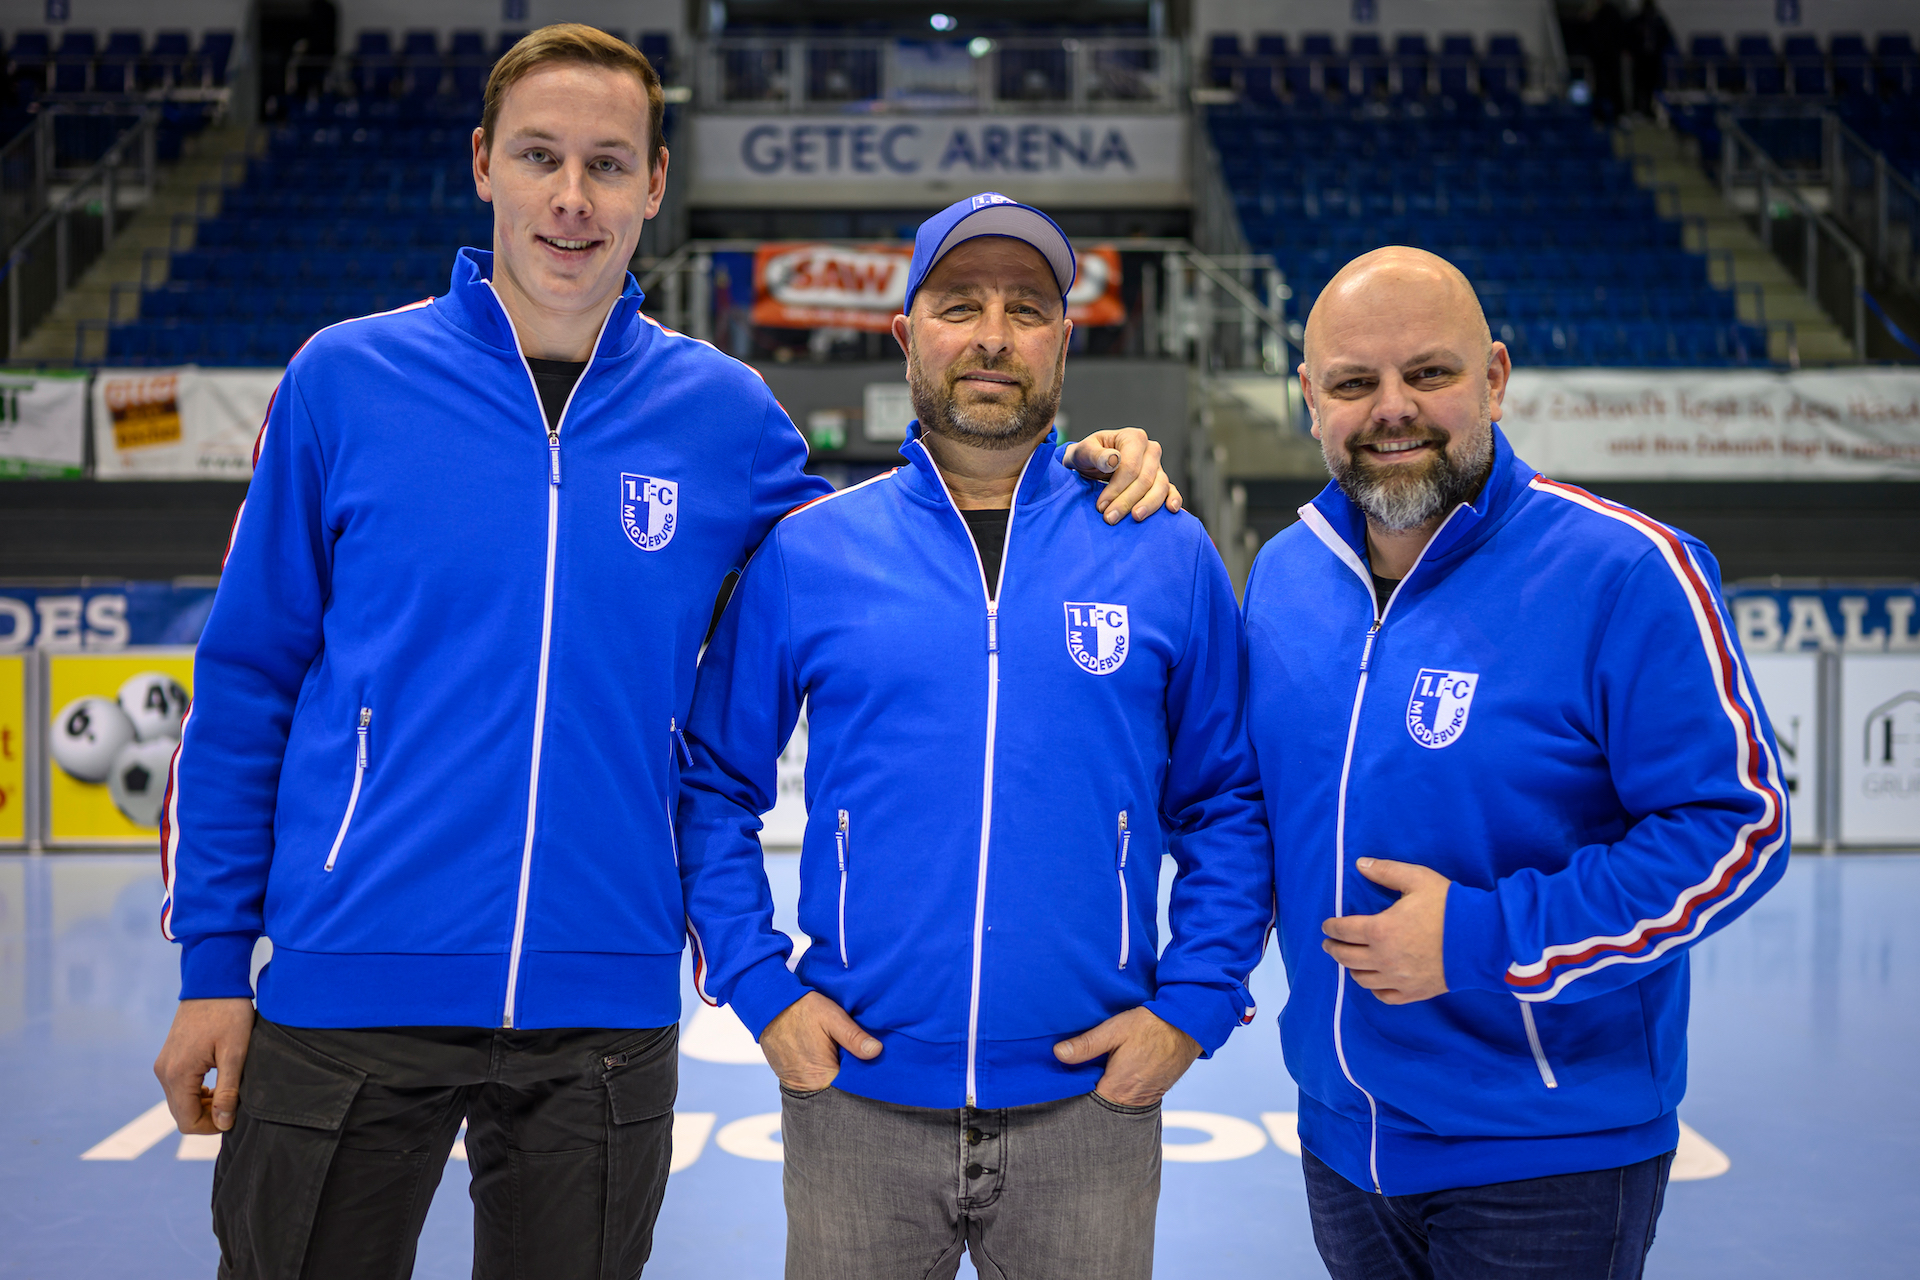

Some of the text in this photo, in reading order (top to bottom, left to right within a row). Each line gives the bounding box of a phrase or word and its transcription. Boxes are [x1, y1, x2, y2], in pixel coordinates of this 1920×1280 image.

[741, 125, 1134, 173] GETEC ARENA
[792, 257, 895, 294] SAW
[624, 480, 674, 506] 1.FC
[624, 504, 674, 547] MAGDEBURG
[1068, 608, 1123, 628] 1.FC
[1070, 631, 1125, 671] MAGDEBURG
[1420, 676, 1470, 699] 1.FC
[1409, 700, 1465, 744] MAGDEBURG
